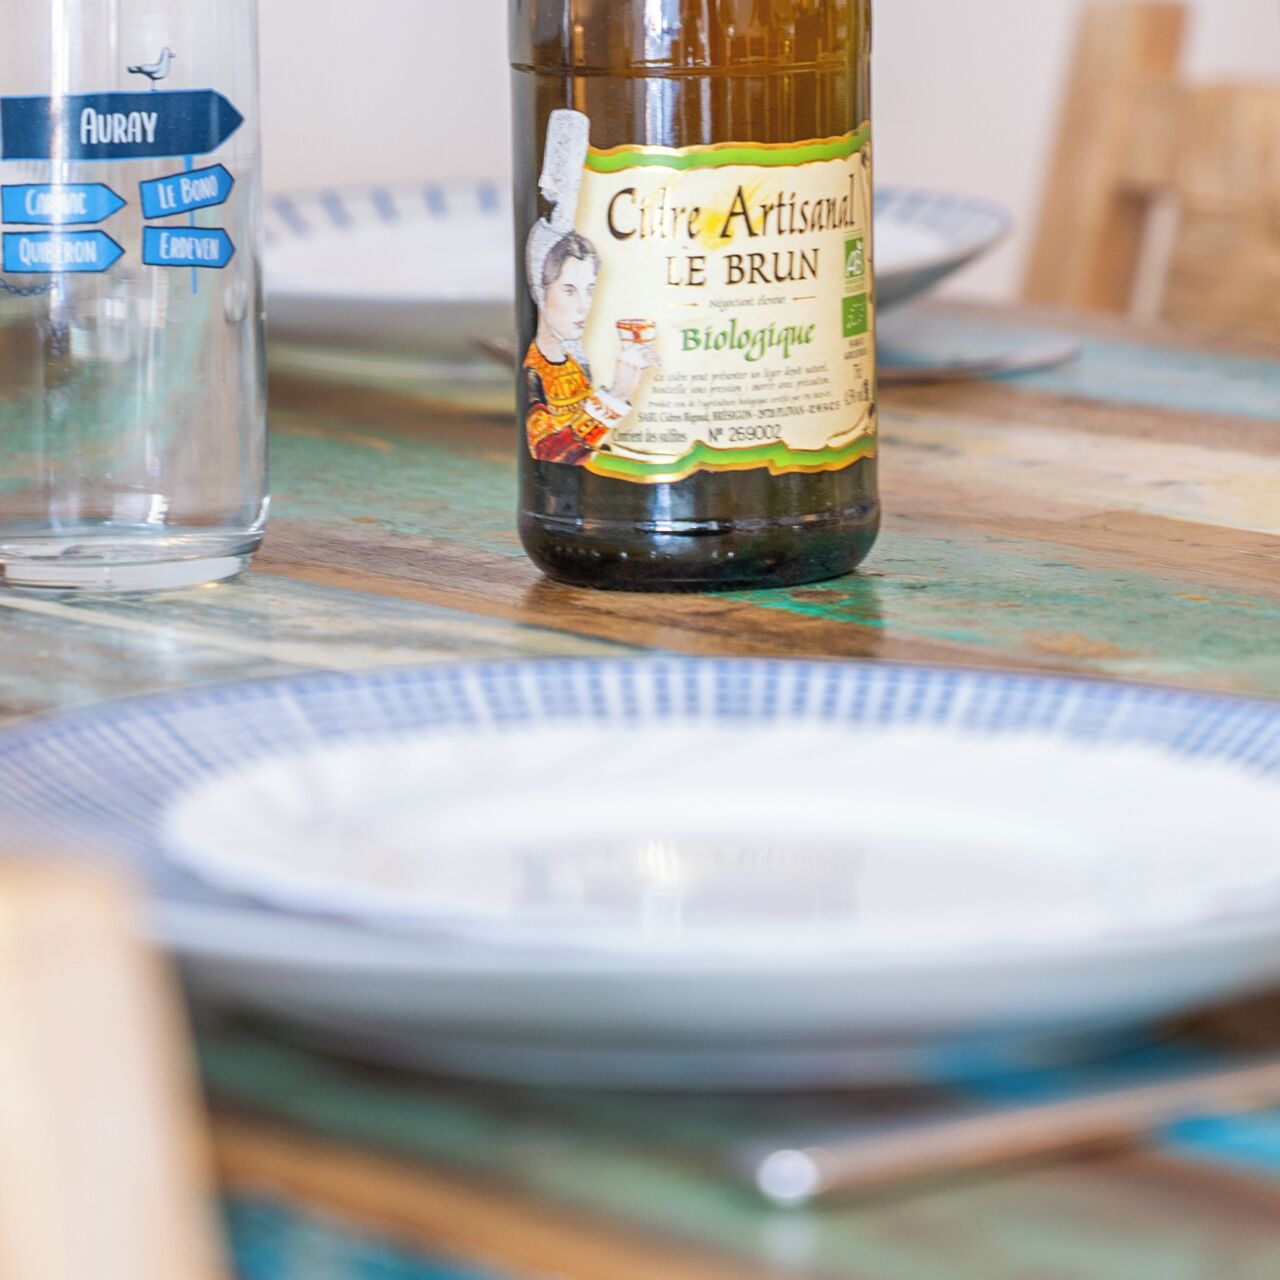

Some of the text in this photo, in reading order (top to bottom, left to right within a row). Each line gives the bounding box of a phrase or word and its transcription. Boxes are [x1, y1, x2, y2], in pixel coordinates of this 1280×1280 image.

[607, 173, 855, 241] Cidre Artisanal
[665, 248, 821, 287] LE BRUN
[680, 318, 816, 362] Biologique
